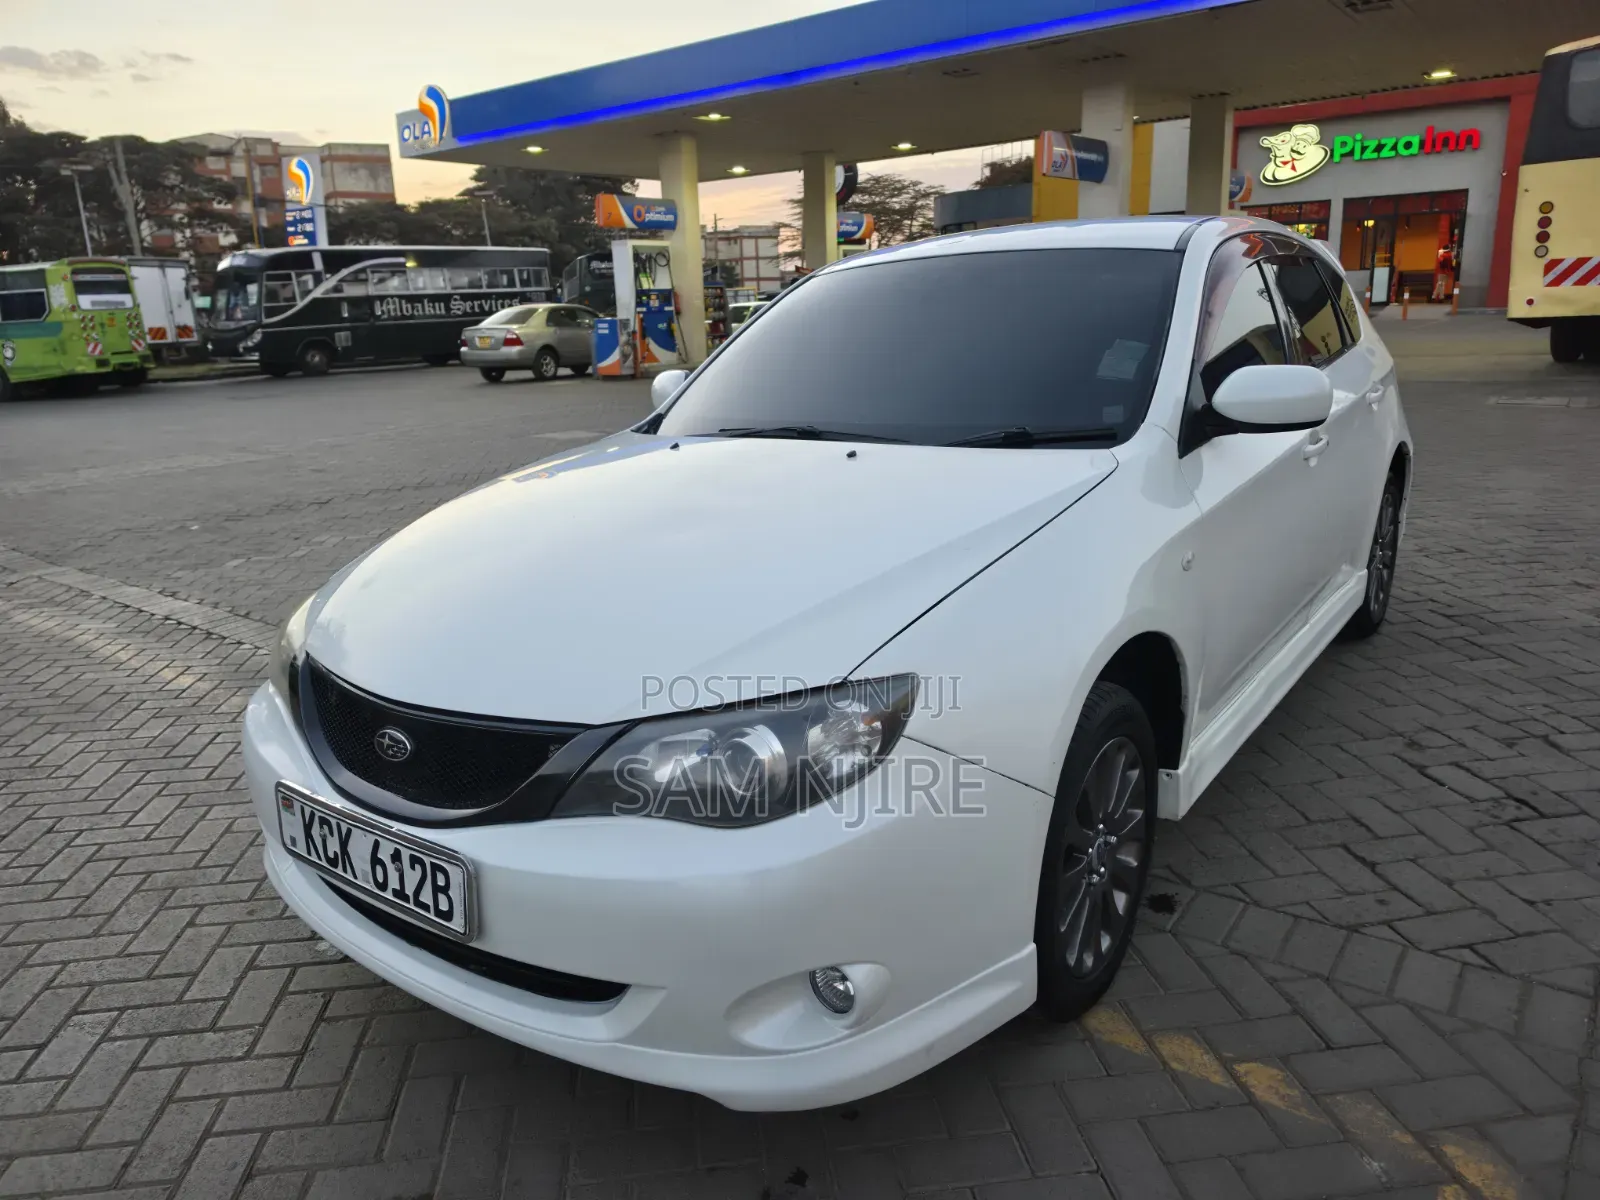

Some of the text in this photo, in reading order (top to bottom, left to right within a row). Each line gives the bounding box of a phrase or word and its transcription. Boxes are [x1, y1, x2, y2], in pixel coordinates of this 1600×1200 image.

[401, 120, 432, 143] OLA
[1333, 125, 1480, 163] Pizza Inn
[380, 297, 446, 319] Mbaku
[450, 295, 521, 315] Services
[300, 803, 357, 881] KCK
[370, 838, 455, 923] 612B
